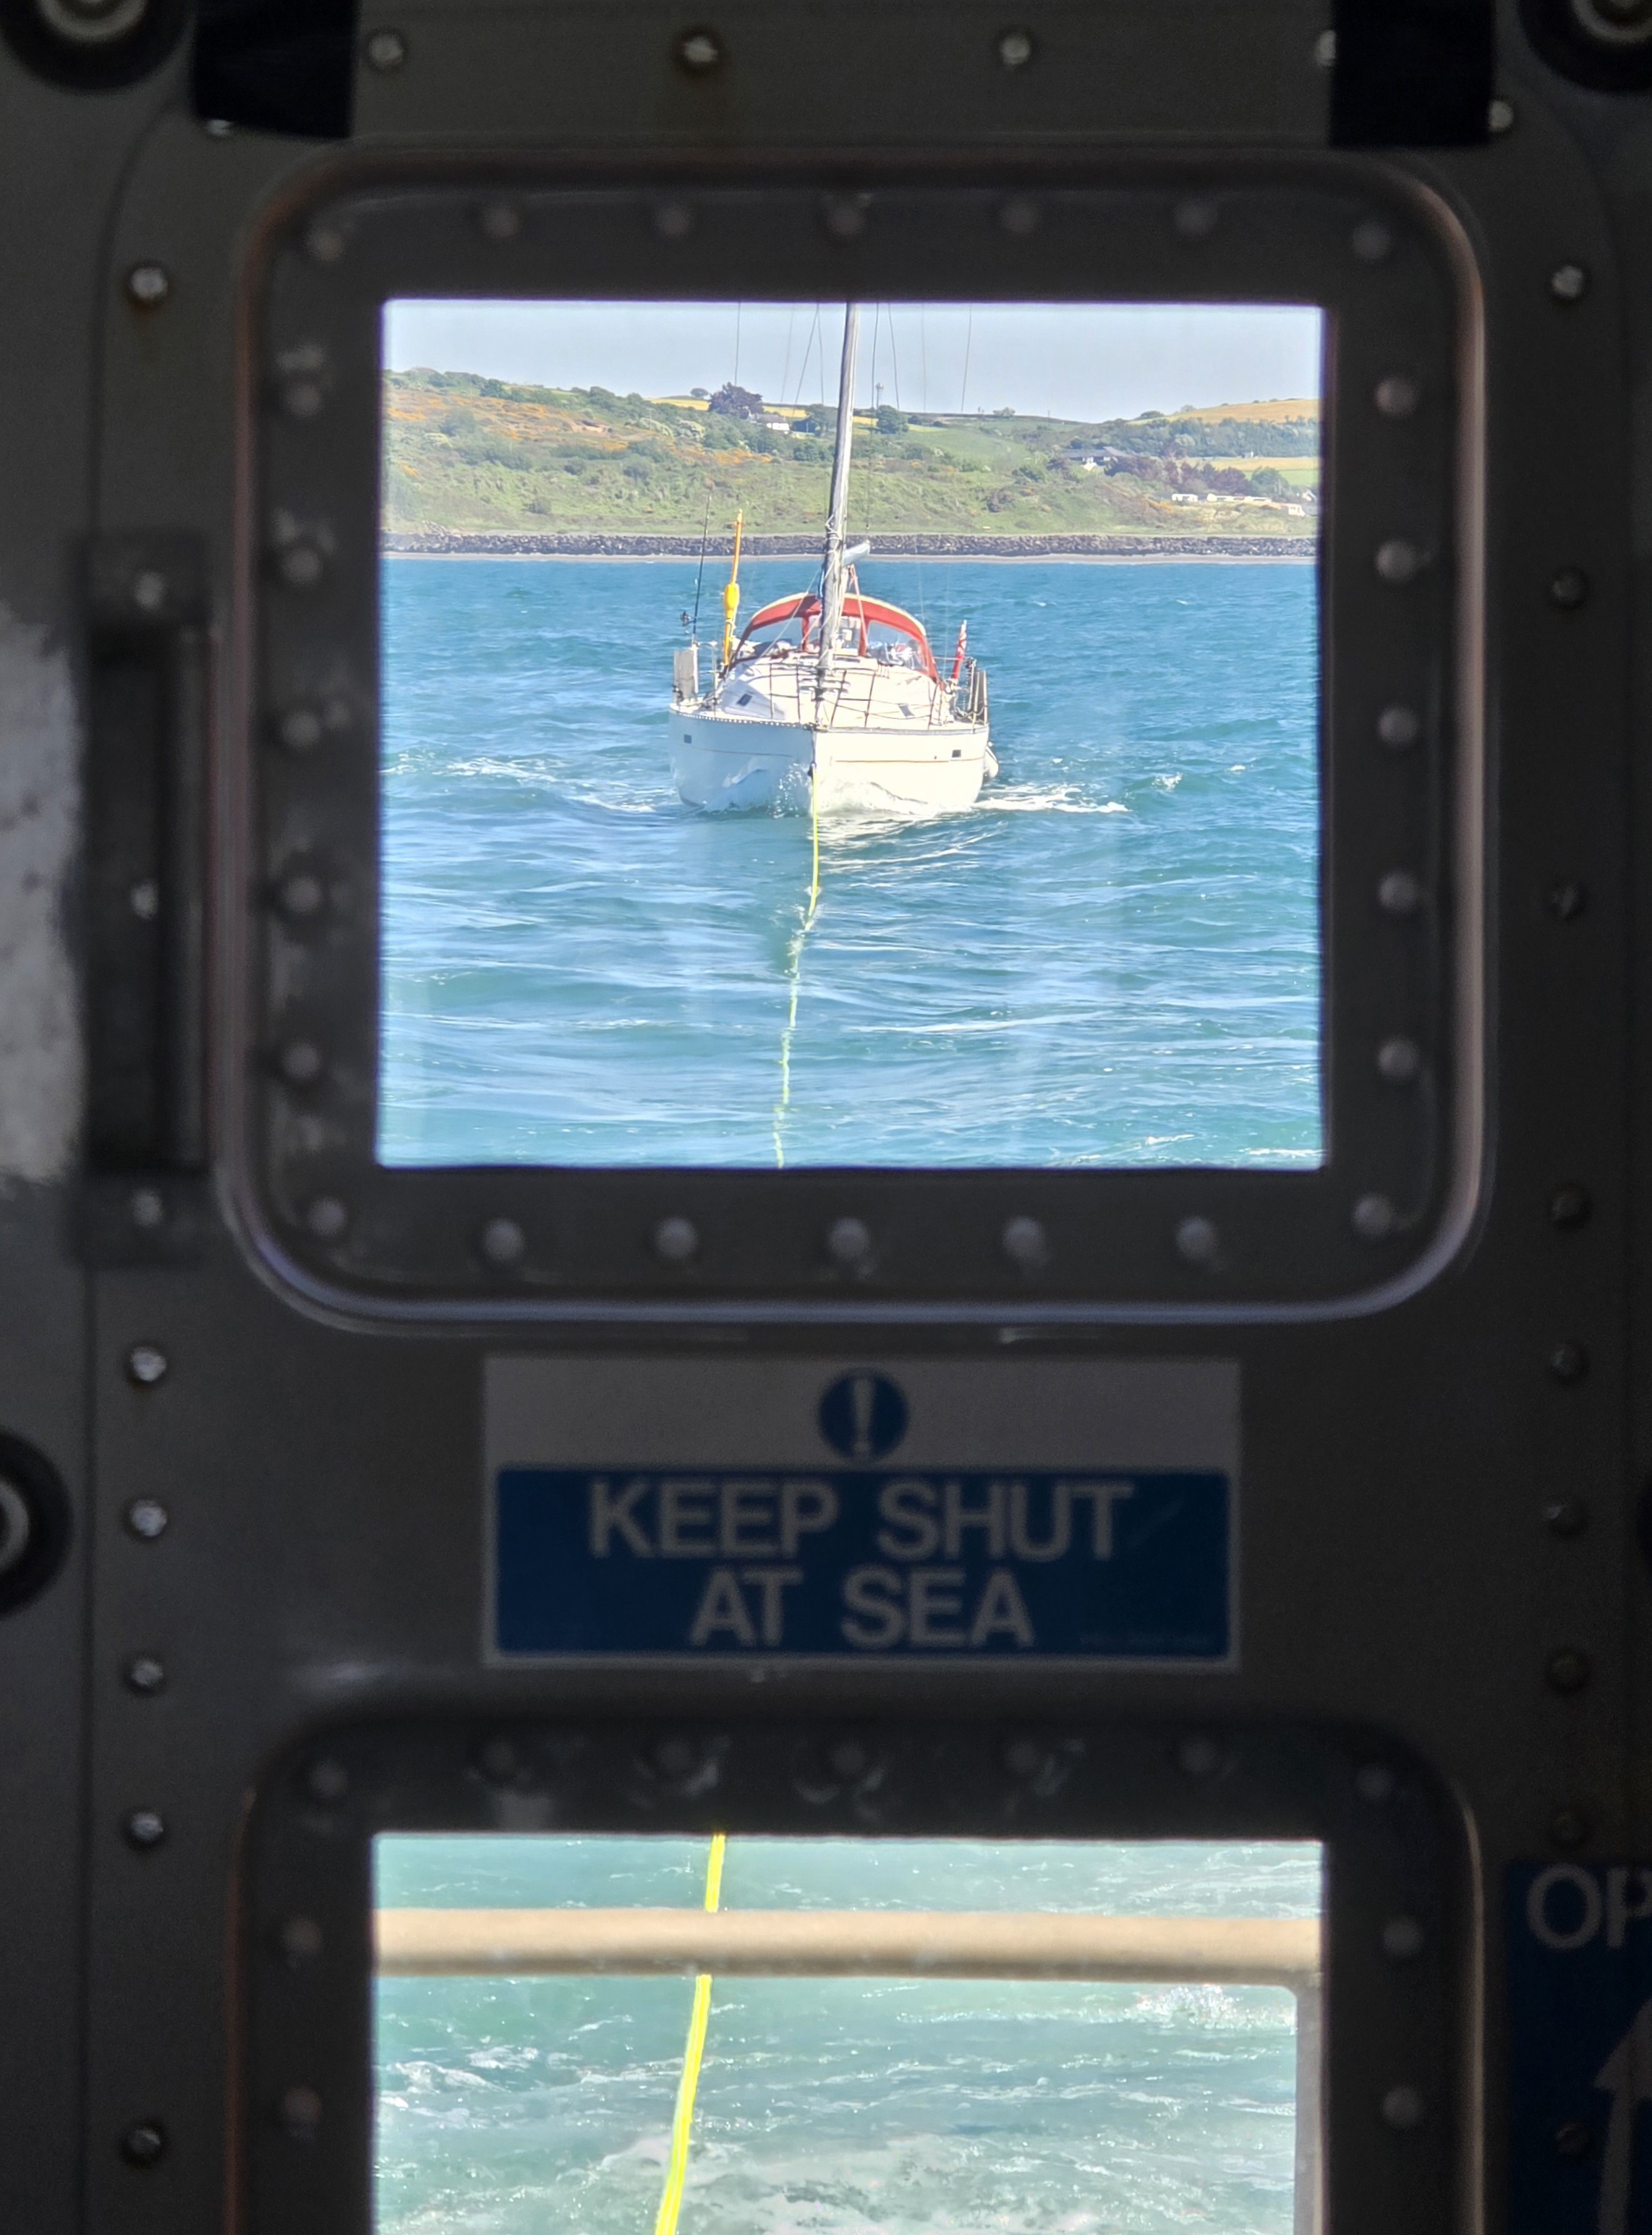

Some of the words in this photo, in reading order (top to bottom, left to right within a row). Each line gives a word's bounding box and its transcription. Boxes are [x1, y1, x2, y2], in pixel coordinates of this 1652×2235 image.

[589, 1477, 839, 1559] KEEP
[877, 1477, 1134, 1562] SHUT
[689, 1565, 804, 1647] AT
[839, 1564, 1036, 1649] SEA
